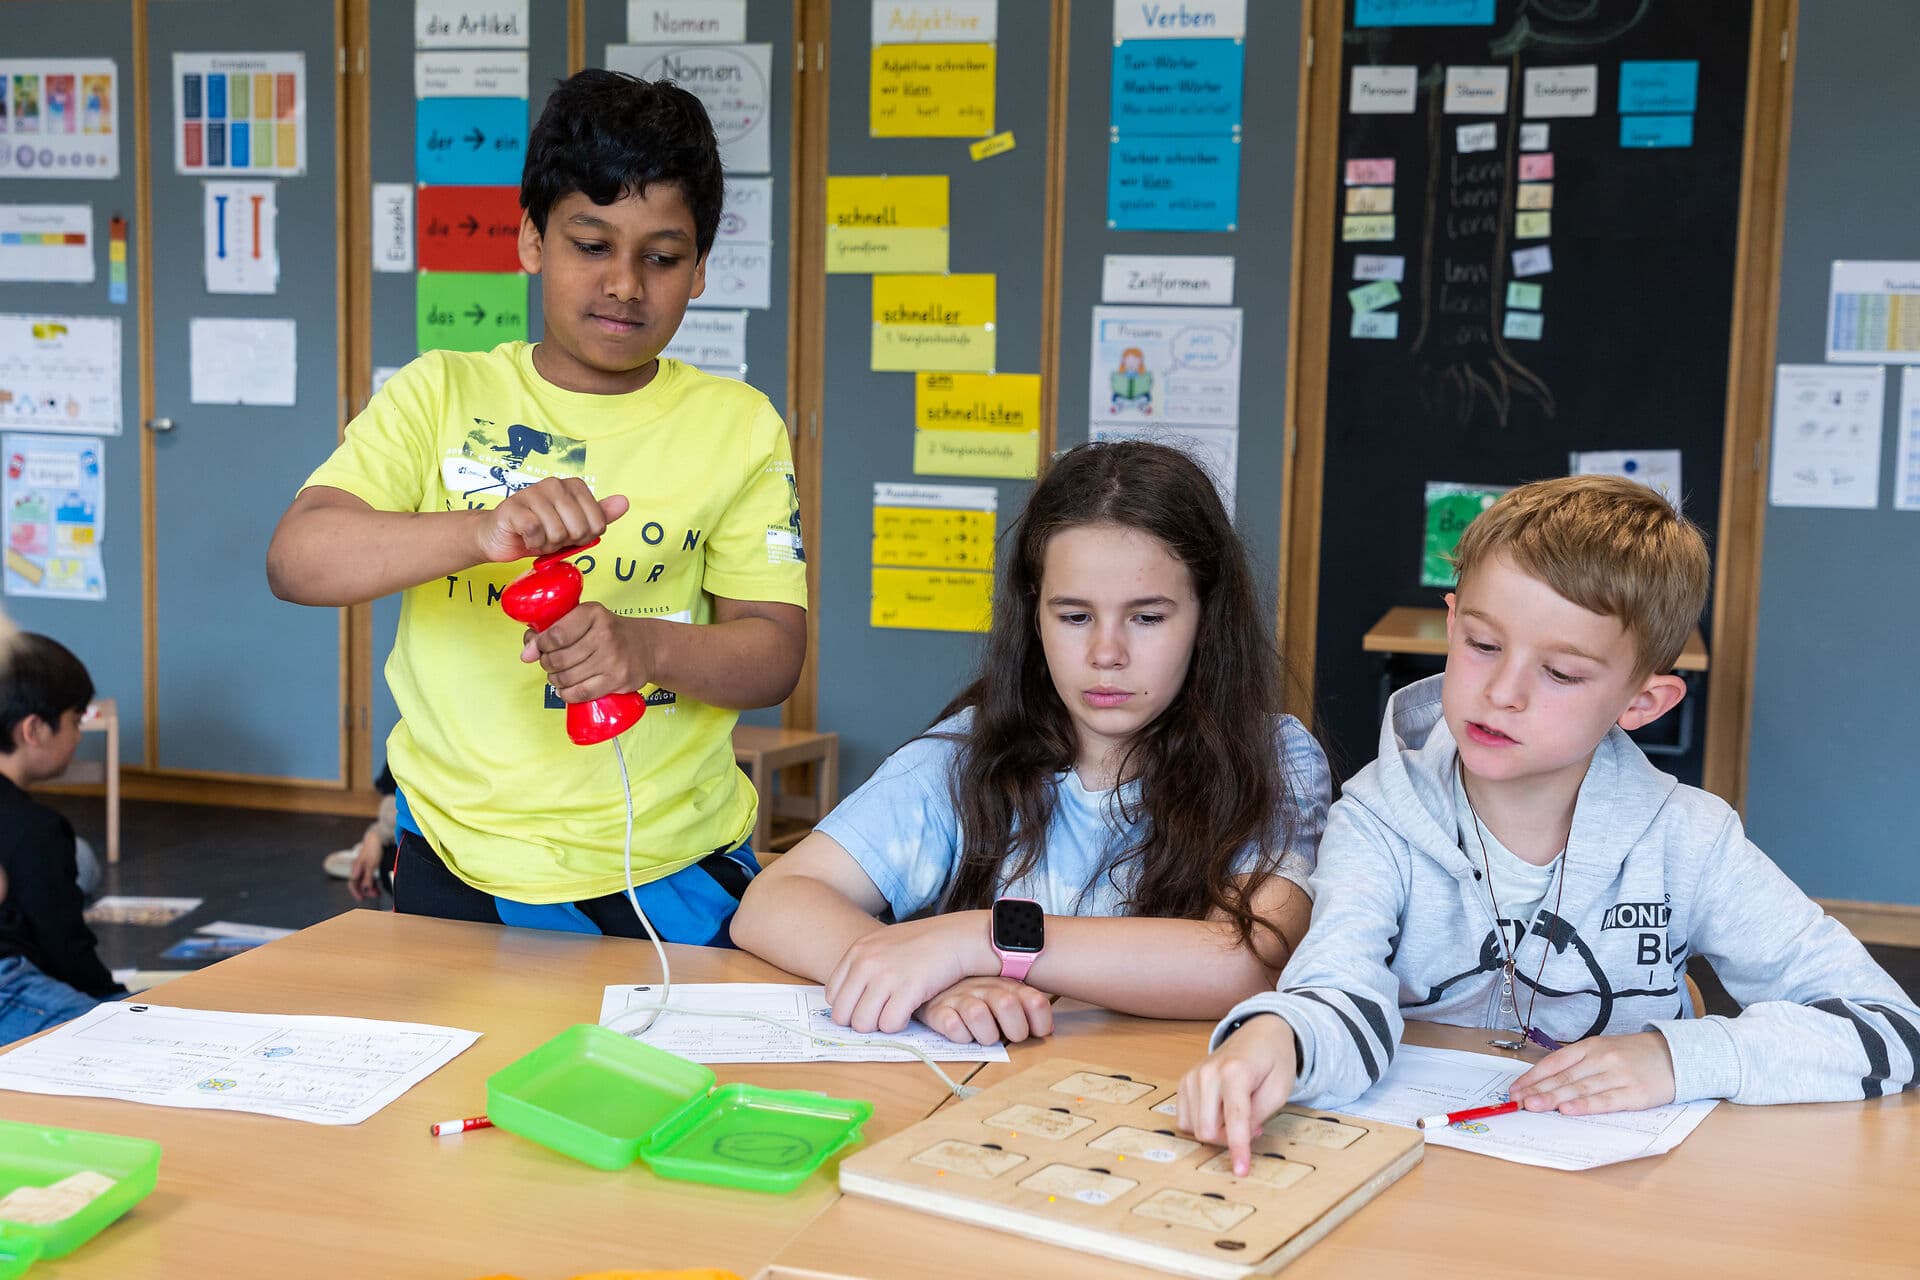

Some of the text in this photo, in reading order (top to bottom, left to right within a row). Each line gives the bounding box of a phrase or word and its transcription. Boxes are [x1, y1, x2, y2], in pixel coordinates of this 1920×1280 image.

[426, 13, 519, 35] die Artikel
[653, 11, 719, 33] Nomen
[888, 8, 981, 42] Adjektive
[1142, 4, 1216, 28] Verben
[662, 56, 742, 82] Nomen
[426, 130, 453, 150] der
[494, 134, 520, 149] ein
[426, 216, 450, 236] die
[837, 206, 897, 226] schnell
[1127, 270, 1211, 298] Zeitformen
[426, 305, 456, 326] das
[495, 313, 521, 325] ein
[883, 304, 961, 326] schneller
[928, 401, 1024, 426] schnellsten
[576, 555, 665, 583] OUR
[446, 575, 507, 606] TIM
[638, 605, 671, 614] SERIES
